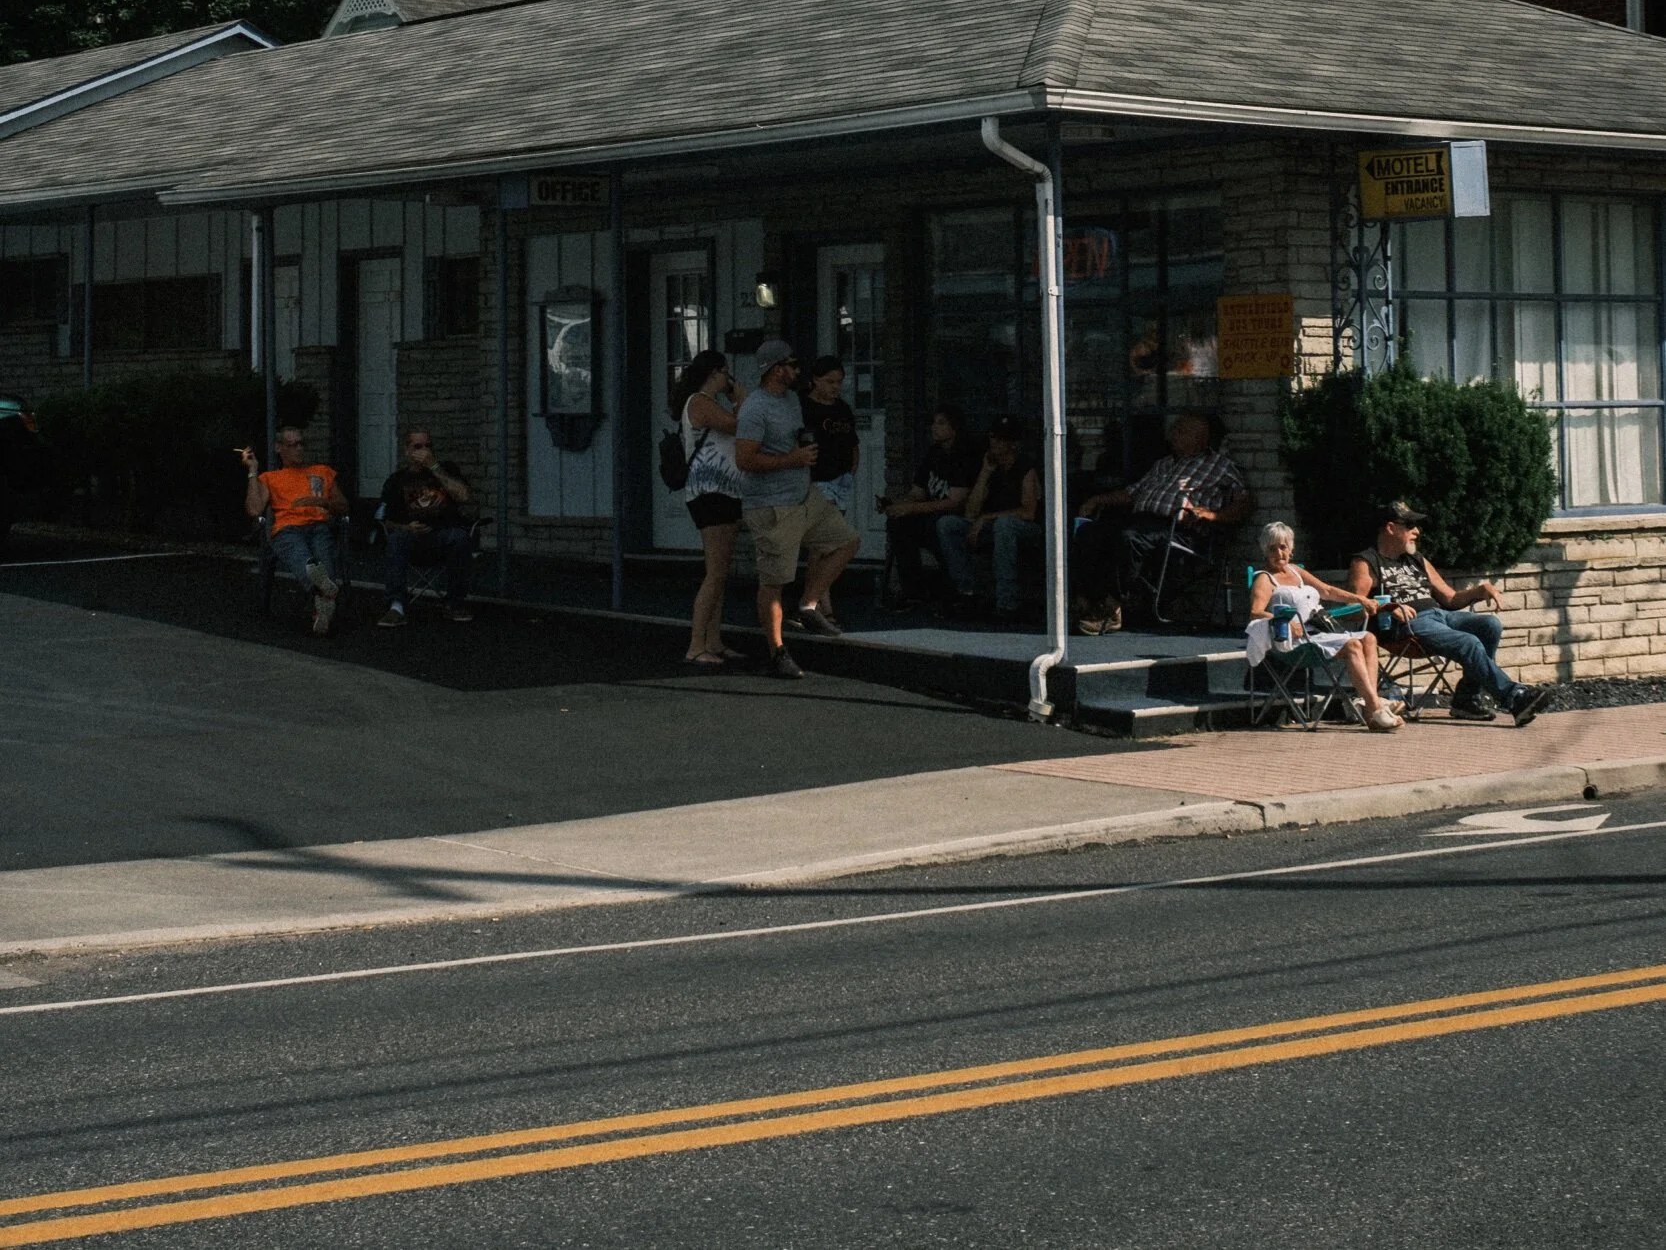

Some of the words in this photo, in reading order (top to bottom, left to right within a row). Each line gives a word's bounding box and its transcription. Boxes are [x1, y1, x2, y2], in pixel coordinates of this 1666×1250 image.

[1376, 156, 1435, 176] MOTEL
[538, 181, 601, 200] OFFICE
[1385, 177, 1445, 196] ENTRANCE
[1403, 196, 1444, 210] VACANCY
